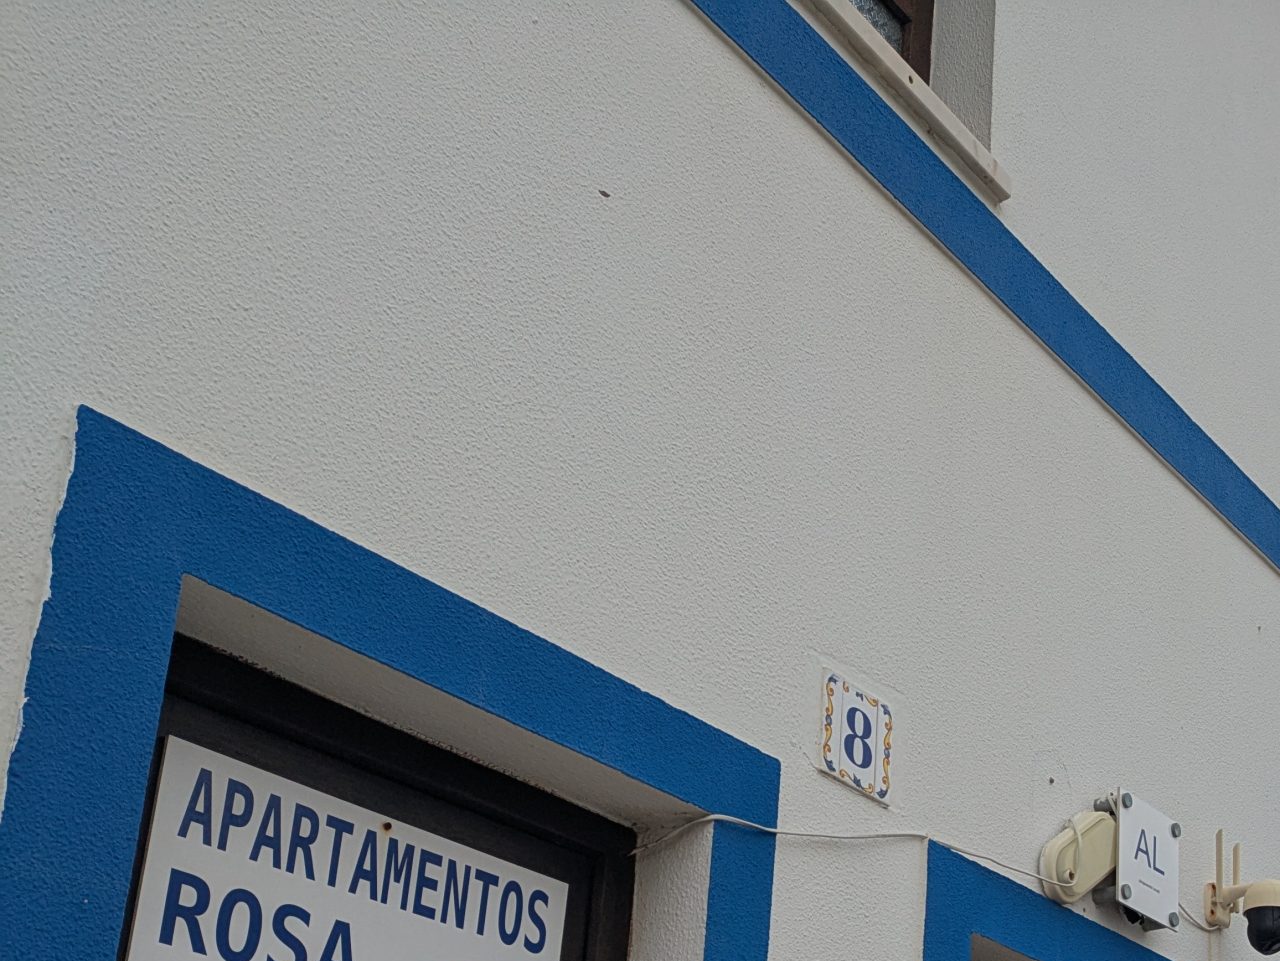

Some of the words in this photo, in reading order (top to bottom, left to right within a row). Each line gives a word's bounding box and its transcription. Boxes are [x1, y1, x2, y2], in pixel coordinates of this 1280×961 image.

[844, 707, 872, 769] 8
[177, 768, 550, 954] APARTAMENTOS
[1134, 829, 1164, 875] AL
